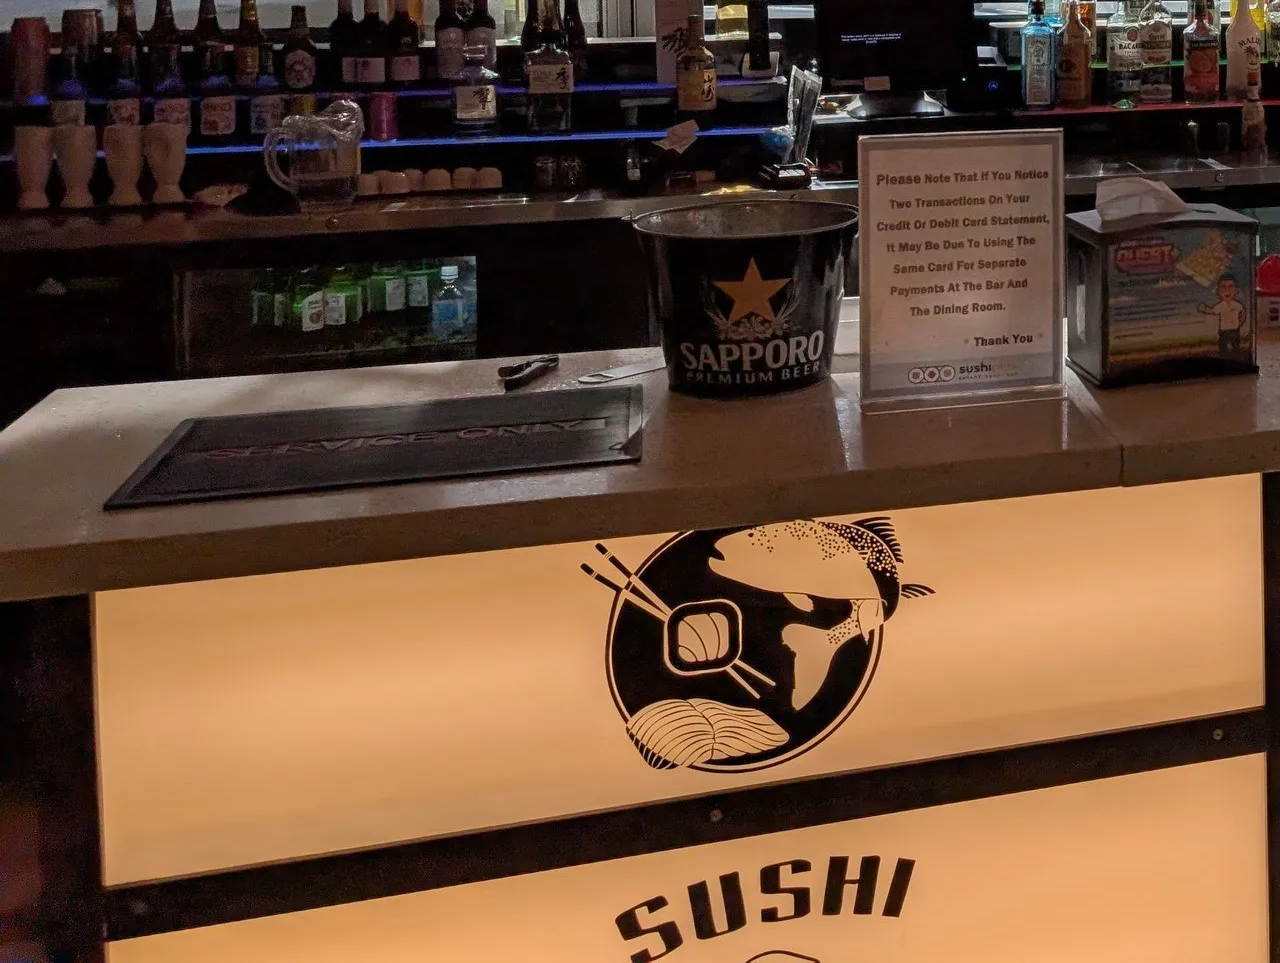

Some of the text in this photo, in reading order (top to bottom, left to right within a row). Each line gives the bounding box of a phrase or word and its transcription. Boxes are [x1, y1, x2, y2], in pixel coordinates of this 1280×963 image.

[876, 169, 1049, 186] Please Note That If You Notice
[889, 193, 1030, 209] Two Transactions On Your
[876, 214, 1050, 232] Credit Or Debit Card Statement,
[886, 235, 1036, 254] It May Be Due To Using The
[893, 258, 1026, 275] Same Card For Separate
[890, 278, 1028, 297] Payments At The Bar And
[910, 301, 1006, 317] The Dining Room.
[974, 334, 1033, 347] Thank You
[679, 329, 824, 372] SAPPORO
[686, 361, 821, 385] PREMIUM BEER
[614, 854, 916, 963] SUSHI
